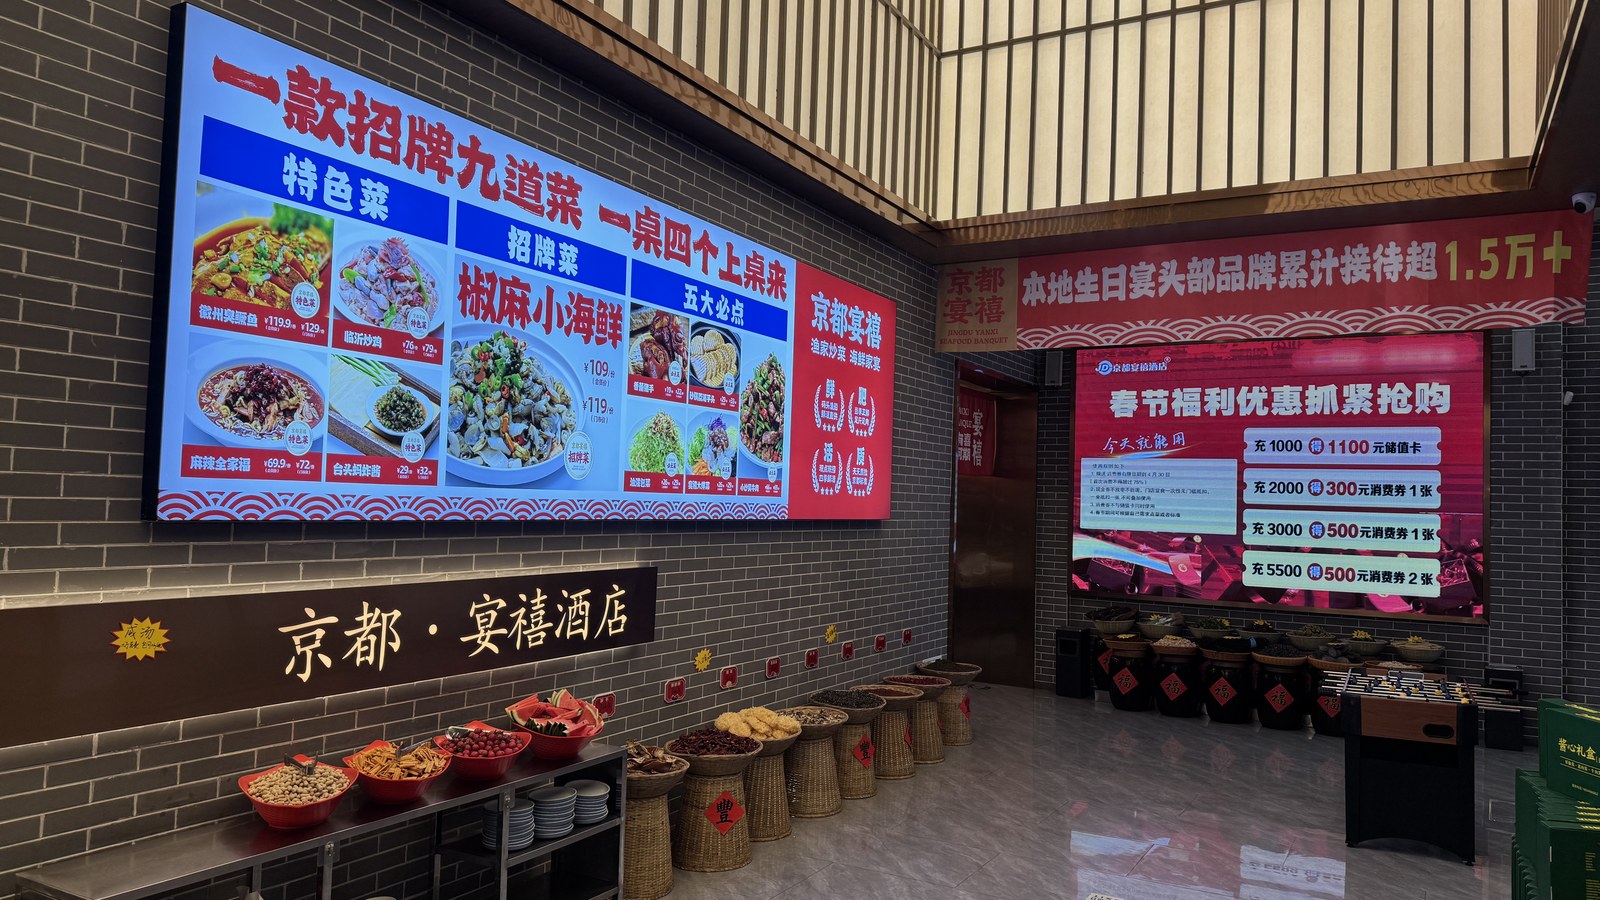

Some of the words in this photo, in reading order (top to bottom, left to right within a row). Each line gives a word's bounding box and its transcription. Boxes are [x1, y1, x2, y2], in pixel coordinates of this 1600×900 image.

[212, 54, 583, 230] 一款招牌九道菜
[599, 203, 787, 303] 一桌四个上桌来
[282, 152, 390, 221] 特色菜
[508, 225, 579, 277] 招牌菜
[945, 266, 1005, 295] 京都
[457, 262, 624, 349] 椒麻小海鲜
[683, 283, 744, 326] 五大必点
[943, 295, 1005, 324] 宴禧
[810, 291, 882, 350] 京都宴禧
[344, 330, 382, 349] 临沂炒鸡
[940, 337, 973, 345] SEAFOOD
[810, 337, 846, 362] 渔家炒菜
[850, 349, 881, 372] 海鲜家宴
[1109, 382, 1451, 418] 春节福利优惠抓紧抢购
[1103, 432, 1186, 454] 今天就能用
[190, 455, 251, 472] 麻辣全家福
[1117, 674, 1132, 689] 福
[1167, 678, 1180, 695] 福
[1215, 684, 1230, 699] 福
[1272, 690, 1287, 707] 福
[1324, 696, 1341, 711] 福
[1558, 737, 1597, 761] 酱心礼盒
[715, 798, 733, 826] 豐
